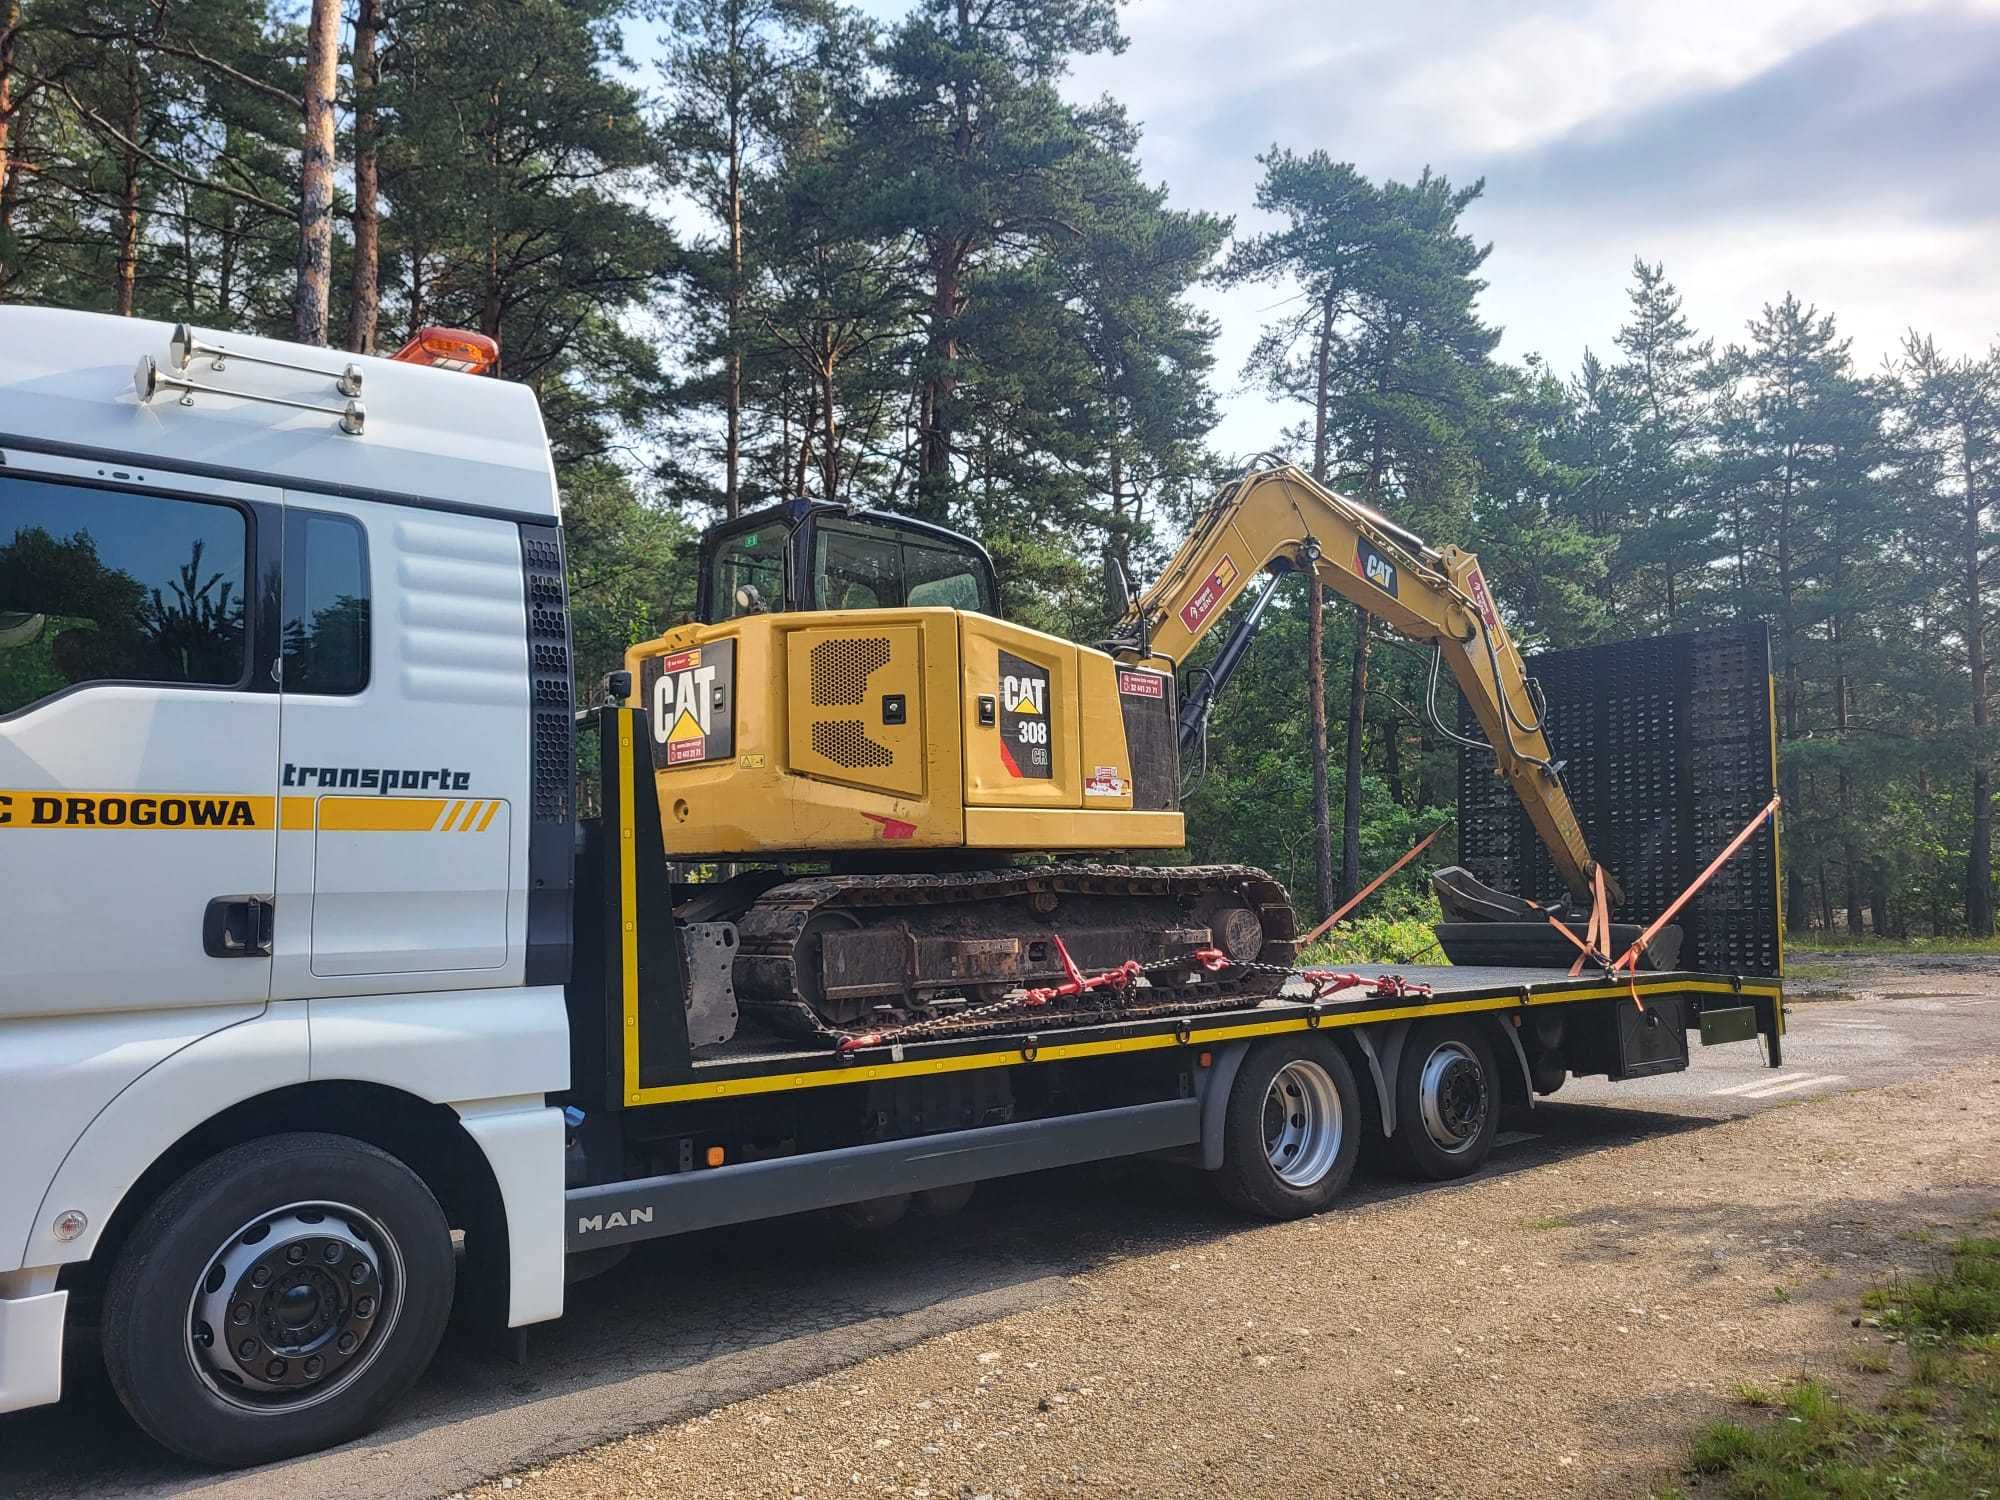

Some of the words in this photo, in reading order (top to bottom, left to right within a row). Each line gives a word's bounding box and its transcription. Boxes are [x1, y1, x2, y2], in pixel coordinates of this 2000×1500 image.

[1366, 554, 1393, 589] CAT
[653, 665, 715, 744] CAT
[1003, 675, 1046, 715] CAT
[1018, 721, 1048, 744] 308
[1031, 747, 1049, 765] CR
[282, 763, 471, 795] transporte
[31, 797, 256, 826] DROGOWA
[578, 1206, 653, 1234] MAN
